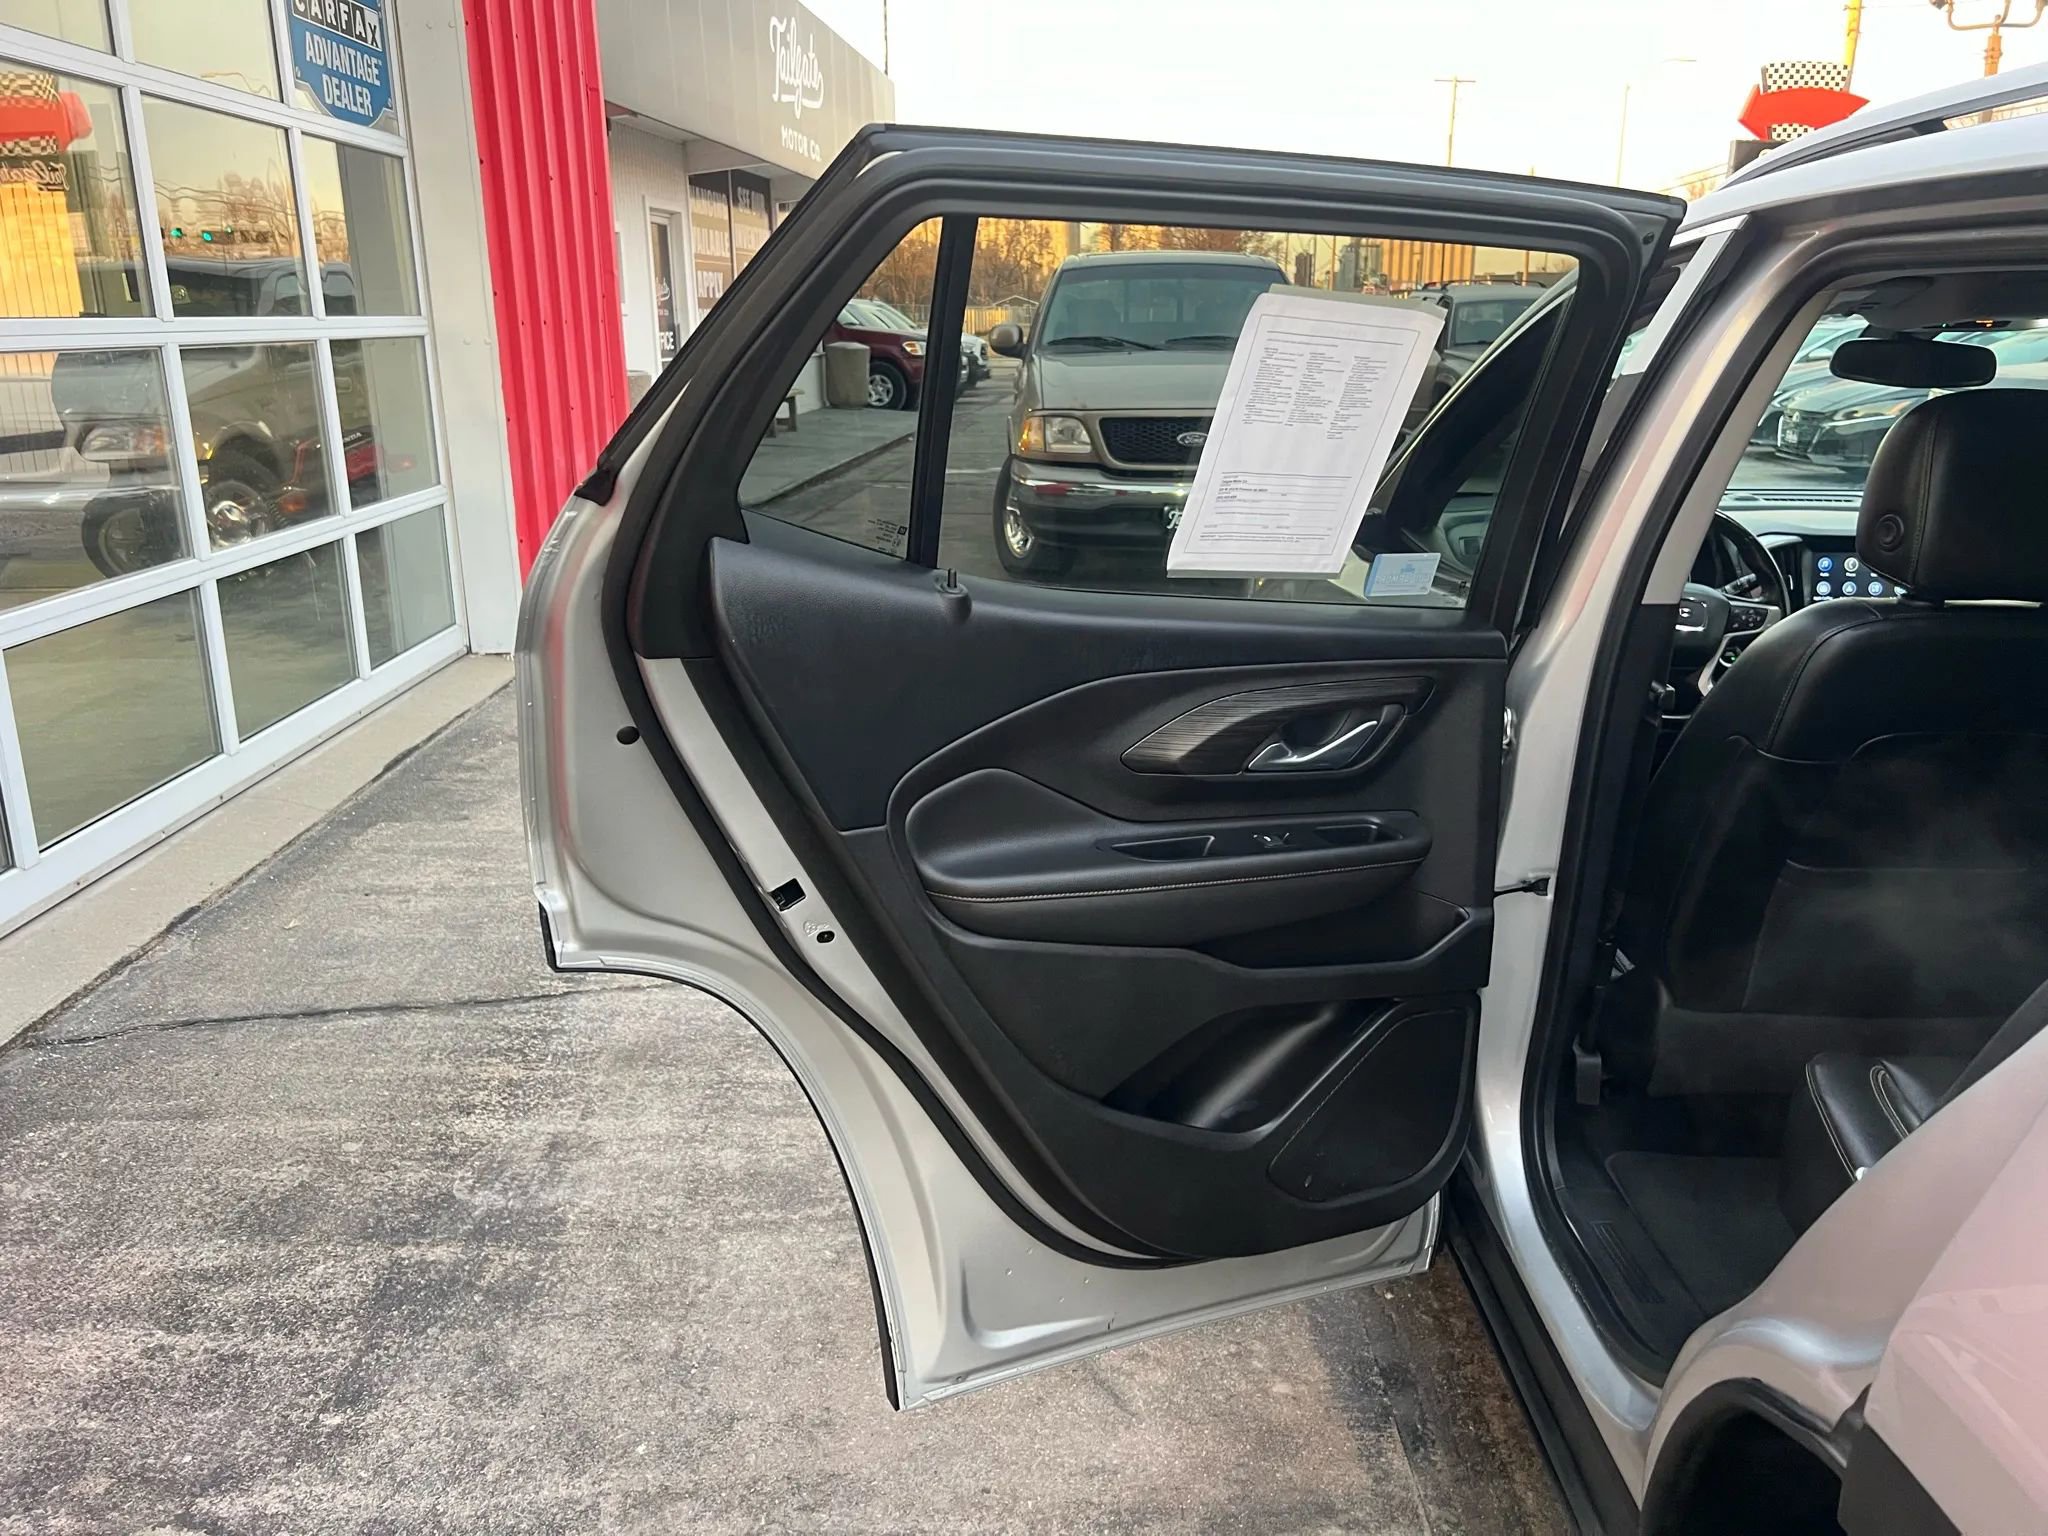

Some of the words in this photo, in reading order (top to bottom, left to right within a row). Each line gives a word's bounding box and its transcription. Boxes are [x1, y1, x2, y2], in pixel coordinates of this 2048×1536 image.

[305, 31, 381, 87] ADVANTAGE
[769, 16, 824, 119] Tailgate
[322, 73, 373, 117] DEALER
[781, 124, 808, 157] MOTOR
[697, 271, 723, 298] APPLY
